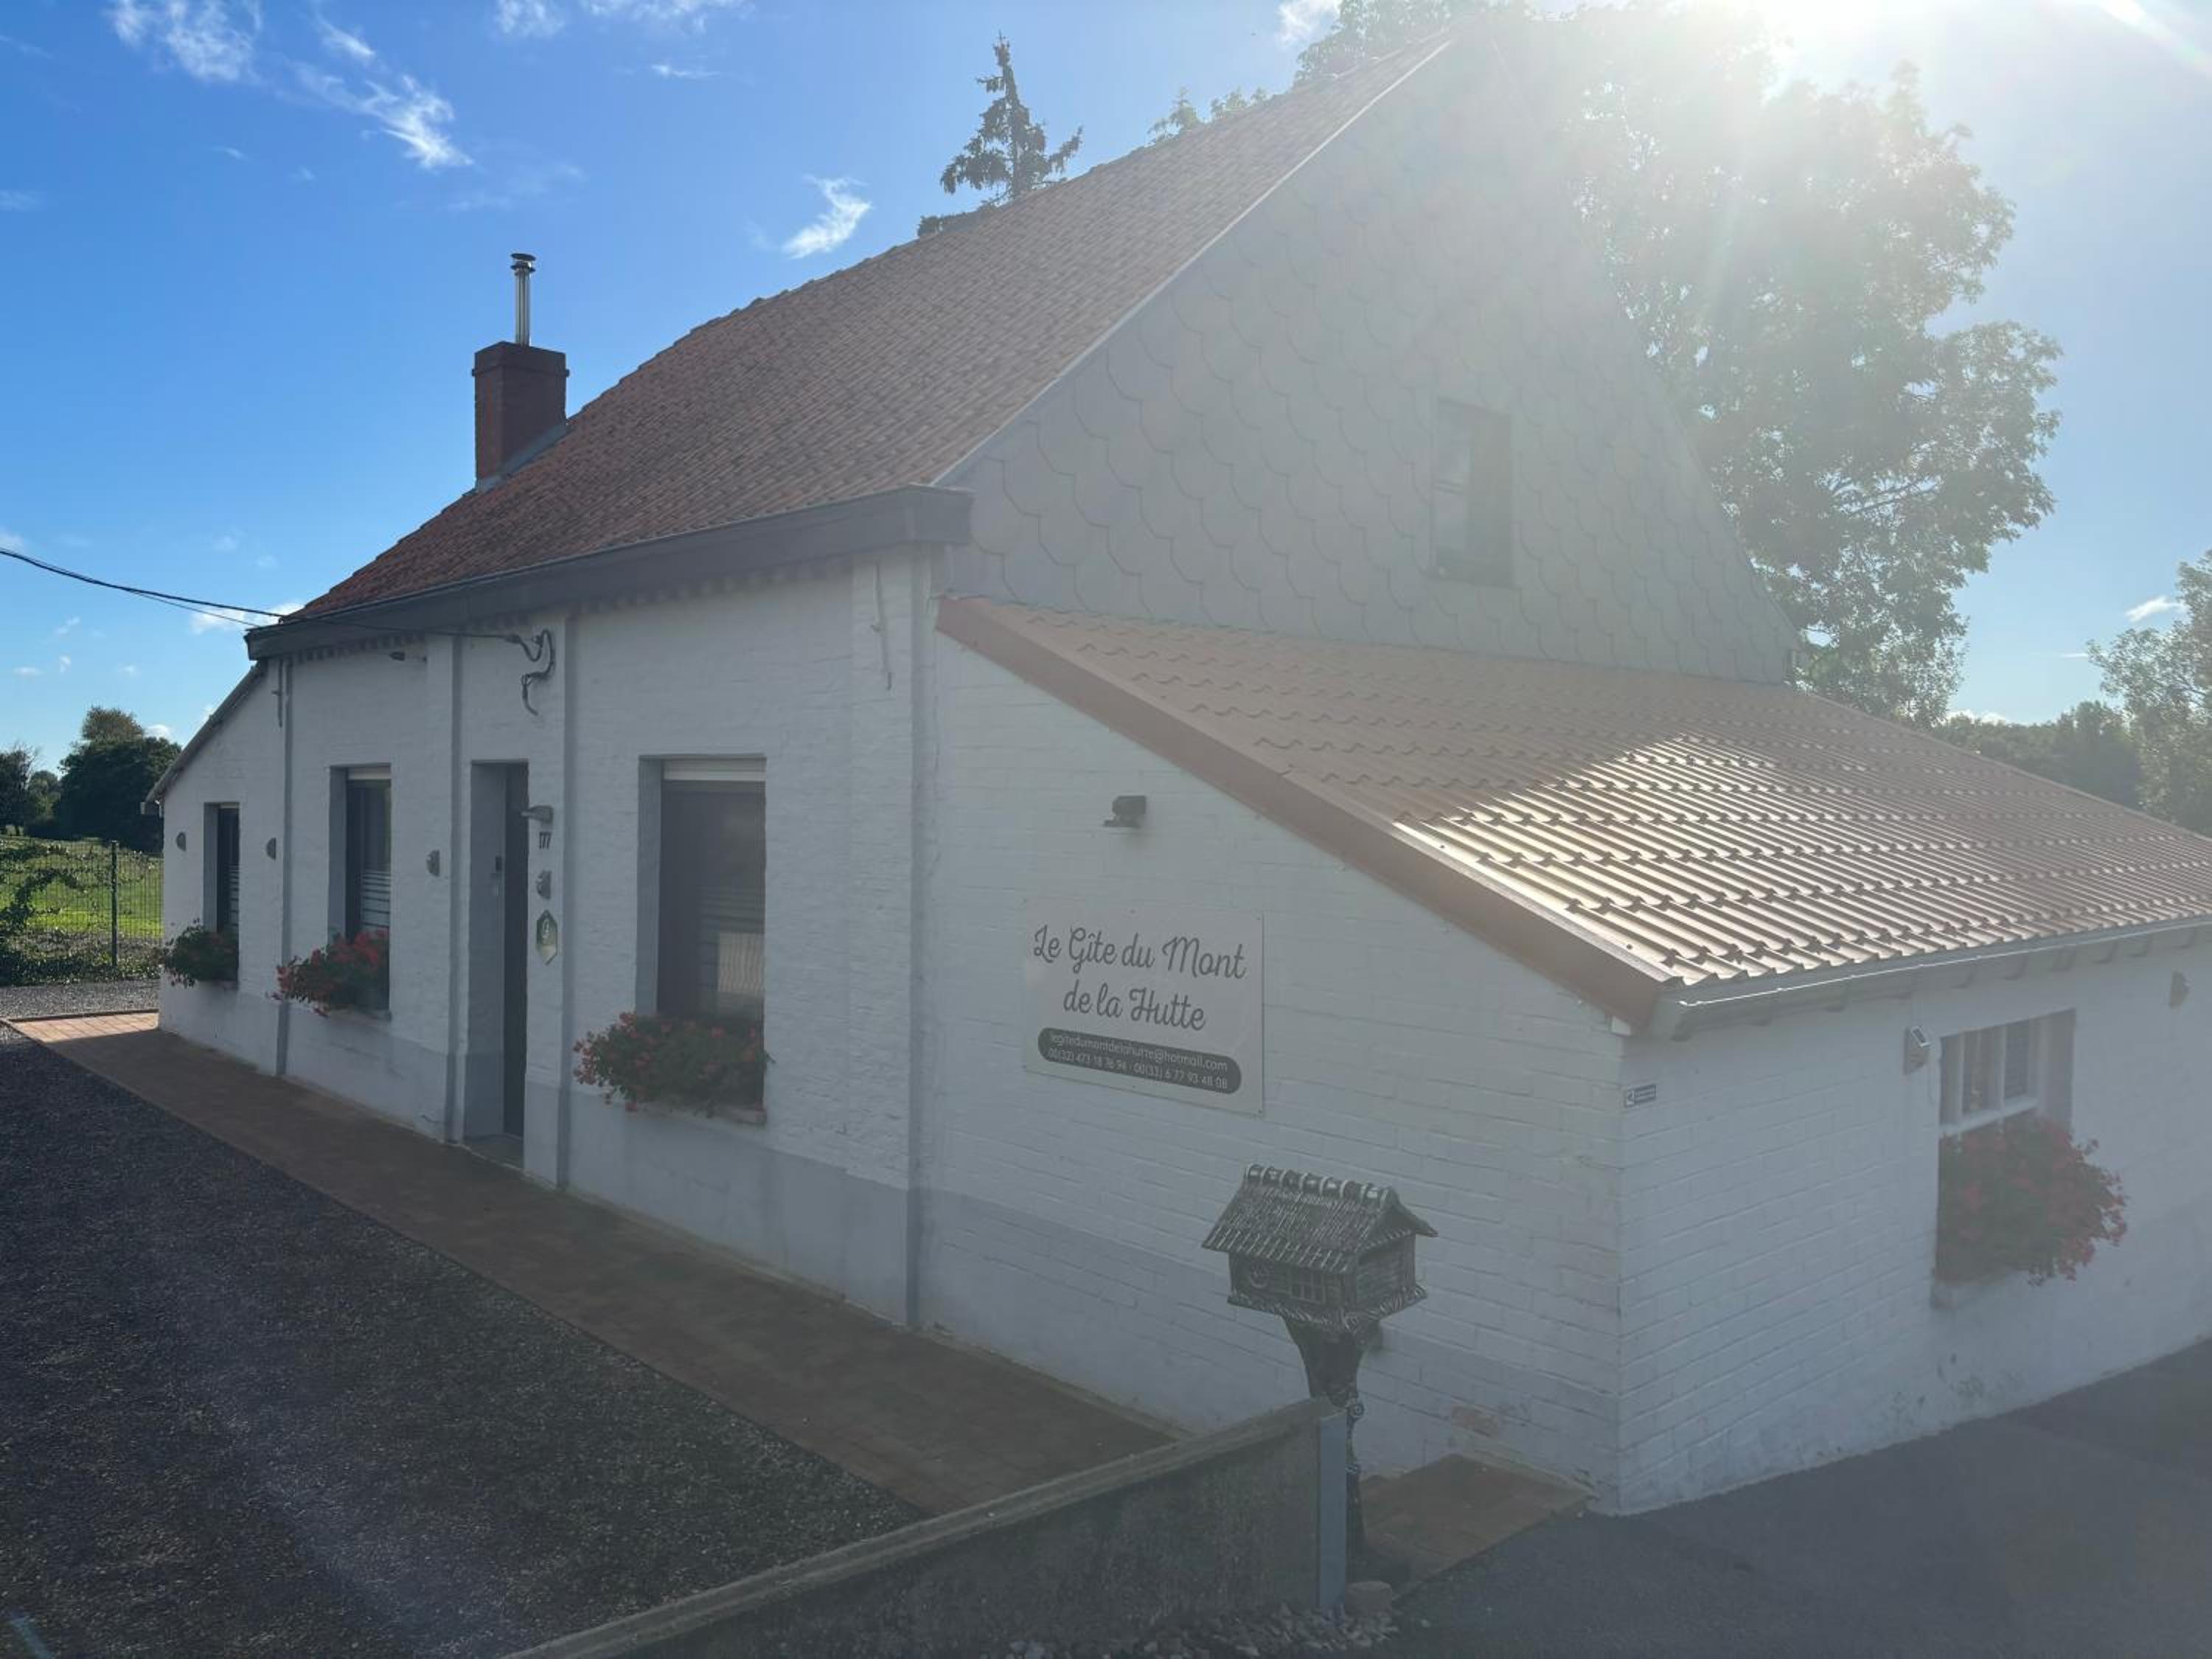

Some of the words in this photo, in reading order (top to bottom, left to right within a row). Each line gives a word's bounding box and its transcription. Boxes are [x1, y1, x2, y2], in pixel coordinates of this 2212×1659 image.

[539, 831, 552, 850] 177
[1033, 924, 1062, 964] Le
[1068, 925, 1118, 975] Gîte
[1121, 932, 1155, 969] du
[1161, 936, 1248, 979] Mont
[1063, 978, 1092, 1015] de
[1096, 982, 1123, 1019] la
[1129, 987, 1207, 1031] Hutte
